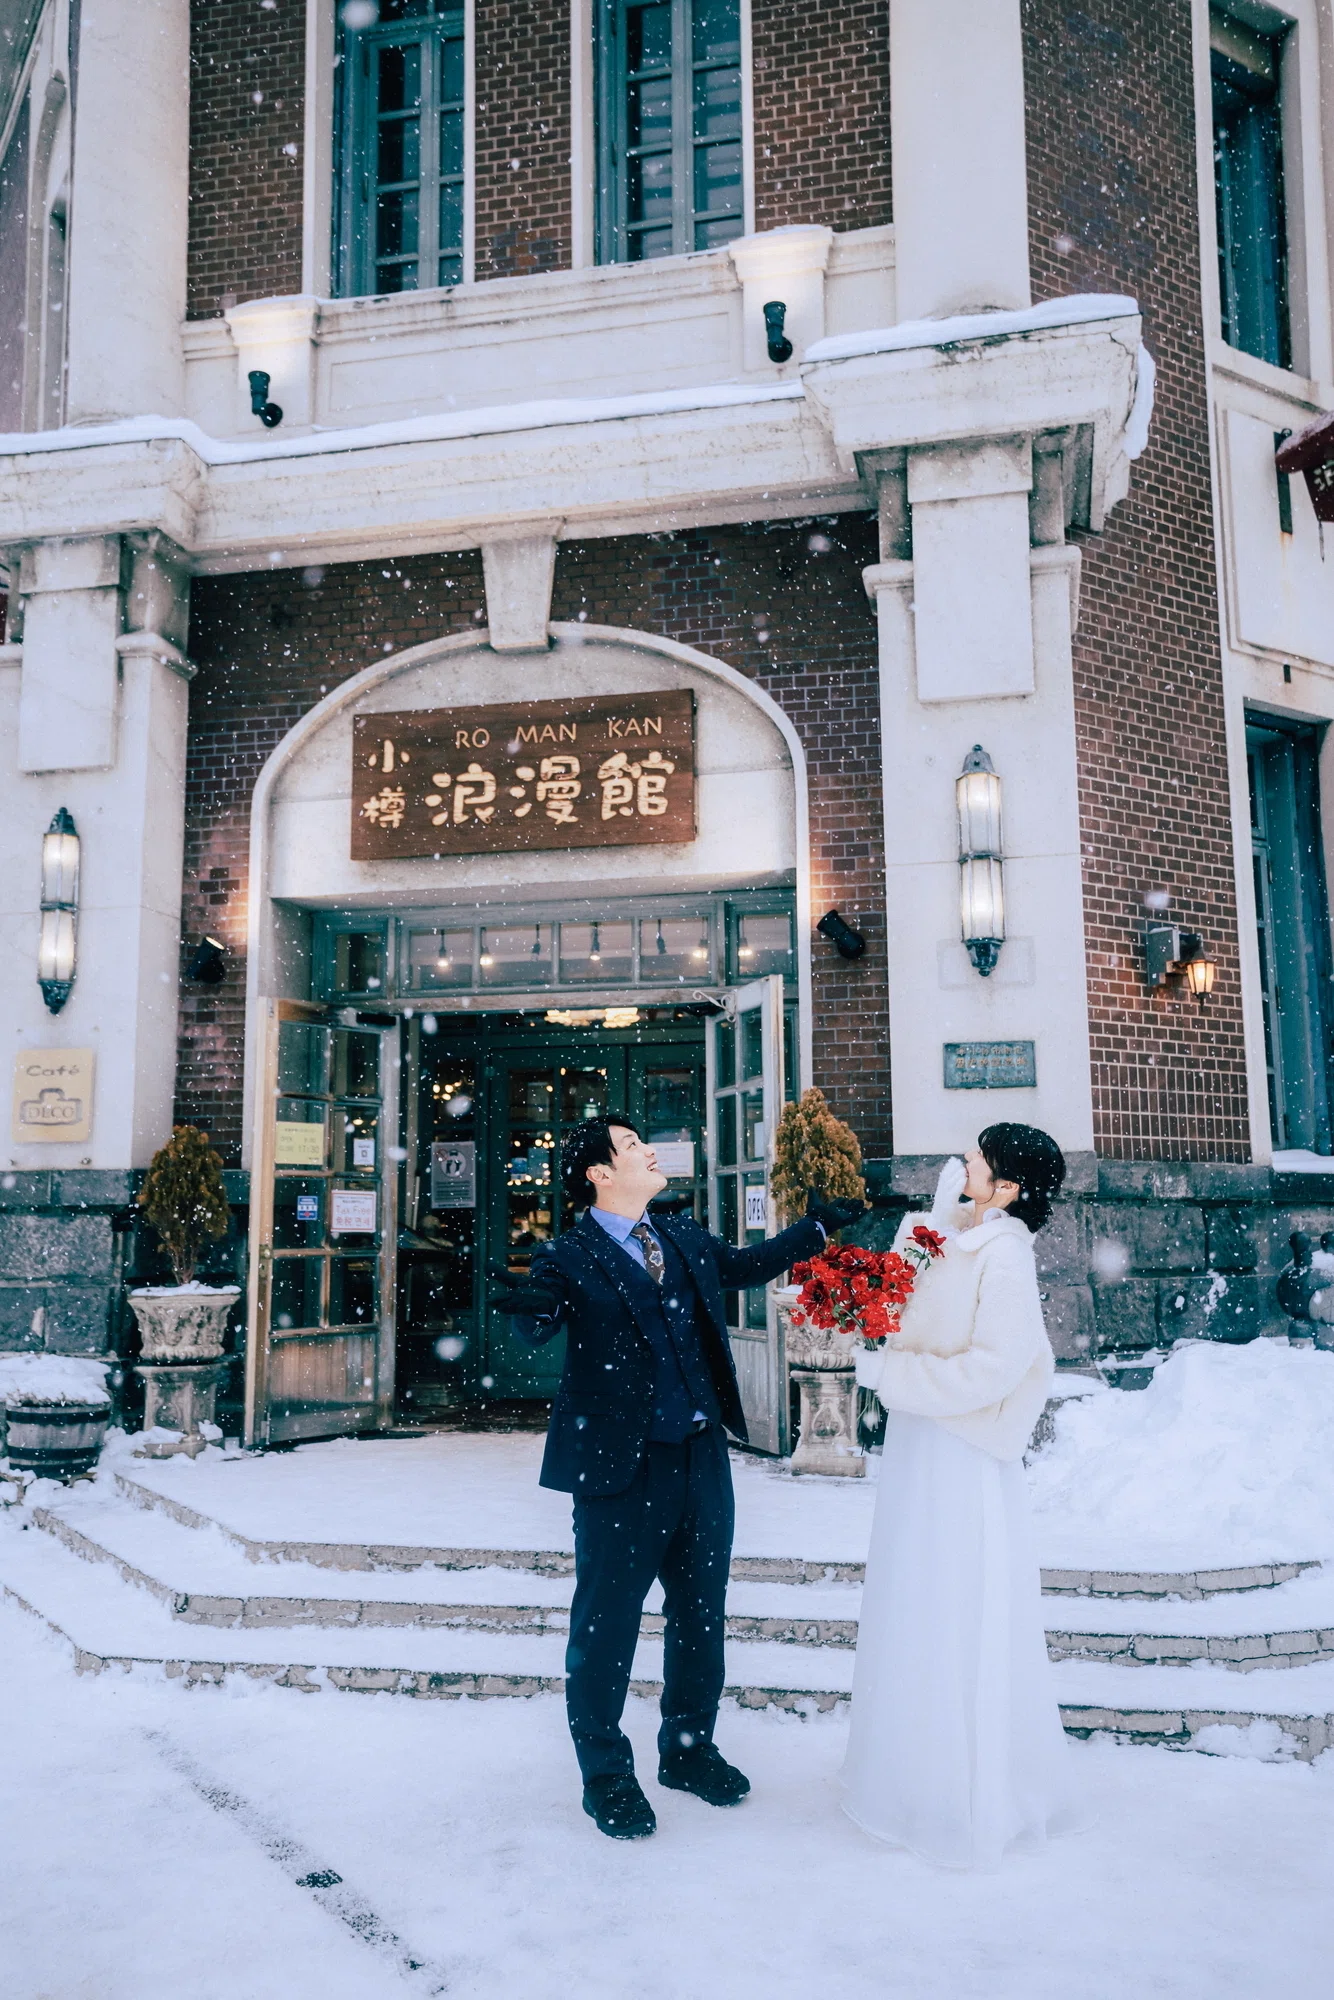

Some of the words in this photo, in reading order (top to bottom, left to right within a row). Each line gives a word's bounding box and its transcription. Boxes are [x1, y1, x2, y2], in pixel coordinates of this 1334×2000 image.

[455, 727, 491, 750] RO
[514, 722, 578, 745] MAN
[607, 716, 663, 738] KAN
[362, 739, 411, 829] 小樽
[424, 750, 676, 827] 浪漫館
[26, 1064, 80, 1077] Café
[28, 1105, 75, 1119] DECO
[747, 1198, 766, 1221] OPEN
